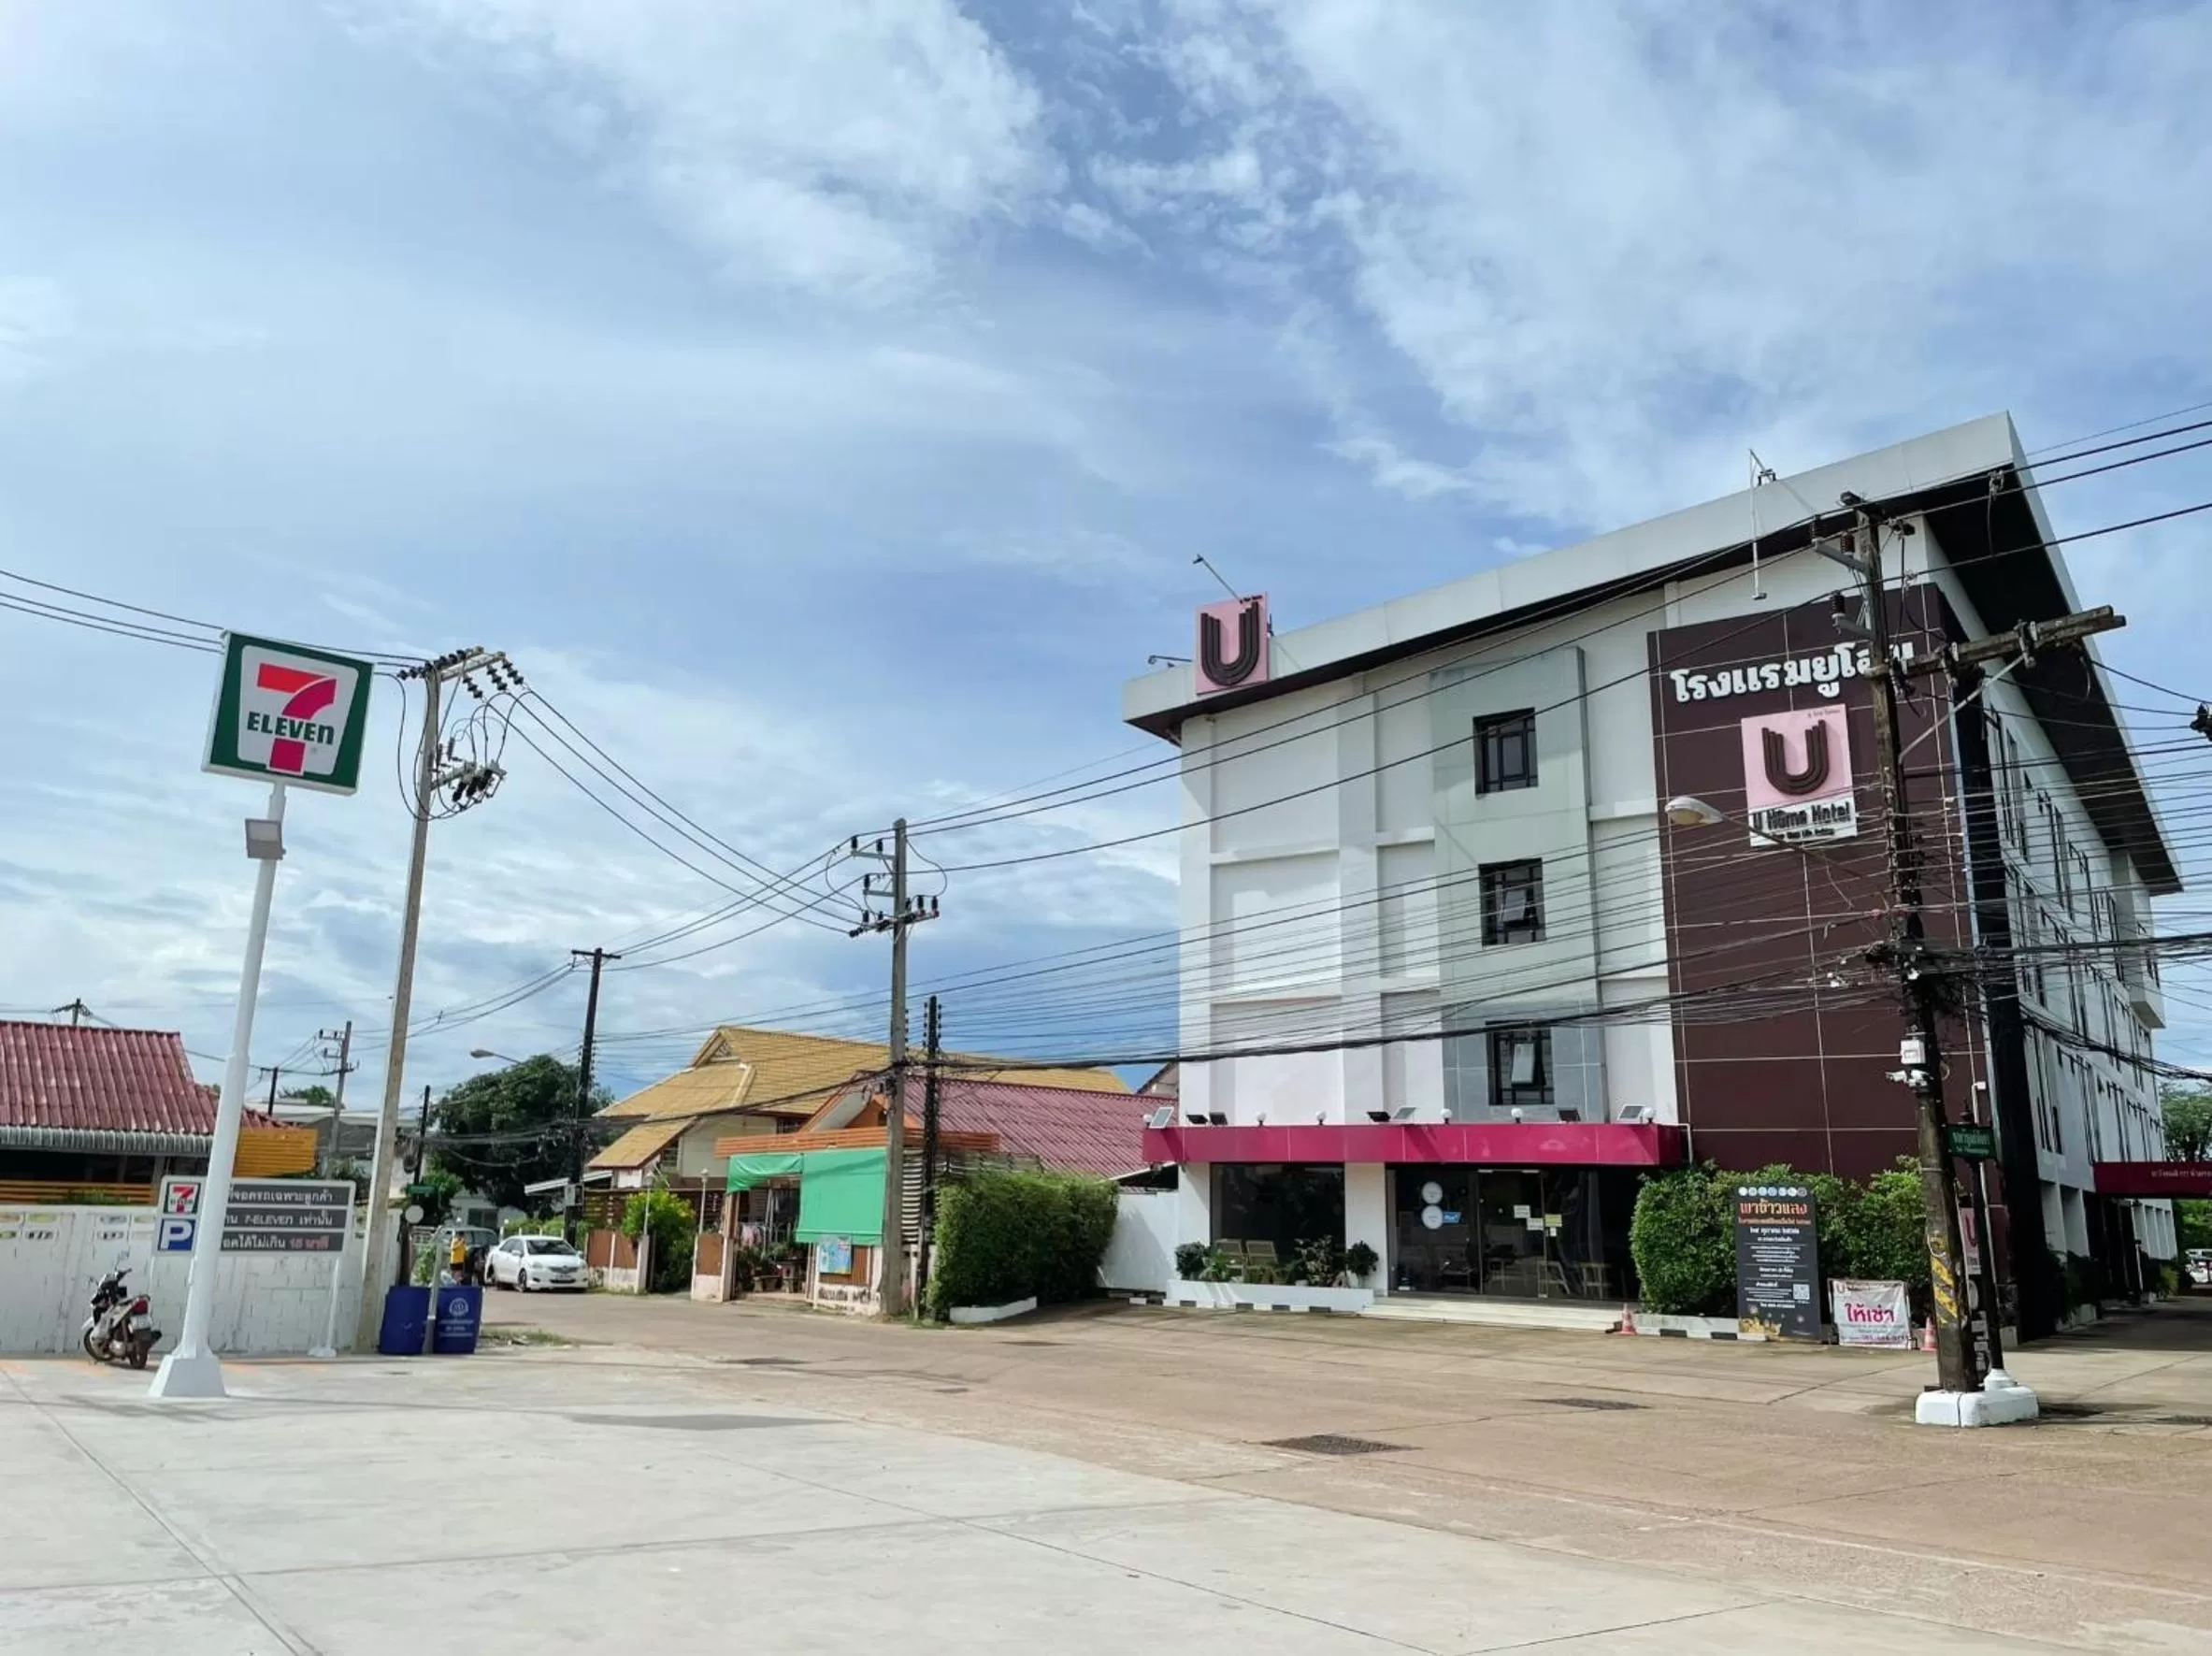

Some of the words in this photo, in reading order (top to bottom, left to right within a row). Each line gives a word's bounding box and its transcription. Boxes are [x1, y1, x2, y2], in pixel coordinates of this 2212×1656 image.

[1199, 601, 1260, 686] U
[1670, 641, 1915, 703] โรงแรมยูโ
[256, 662, 338, 775] 7
[1761, 719, 1831, 797] U
[160, 1219, 193, 1249] P
[1845, 1303, 1895, 1323] ให้เช่า
